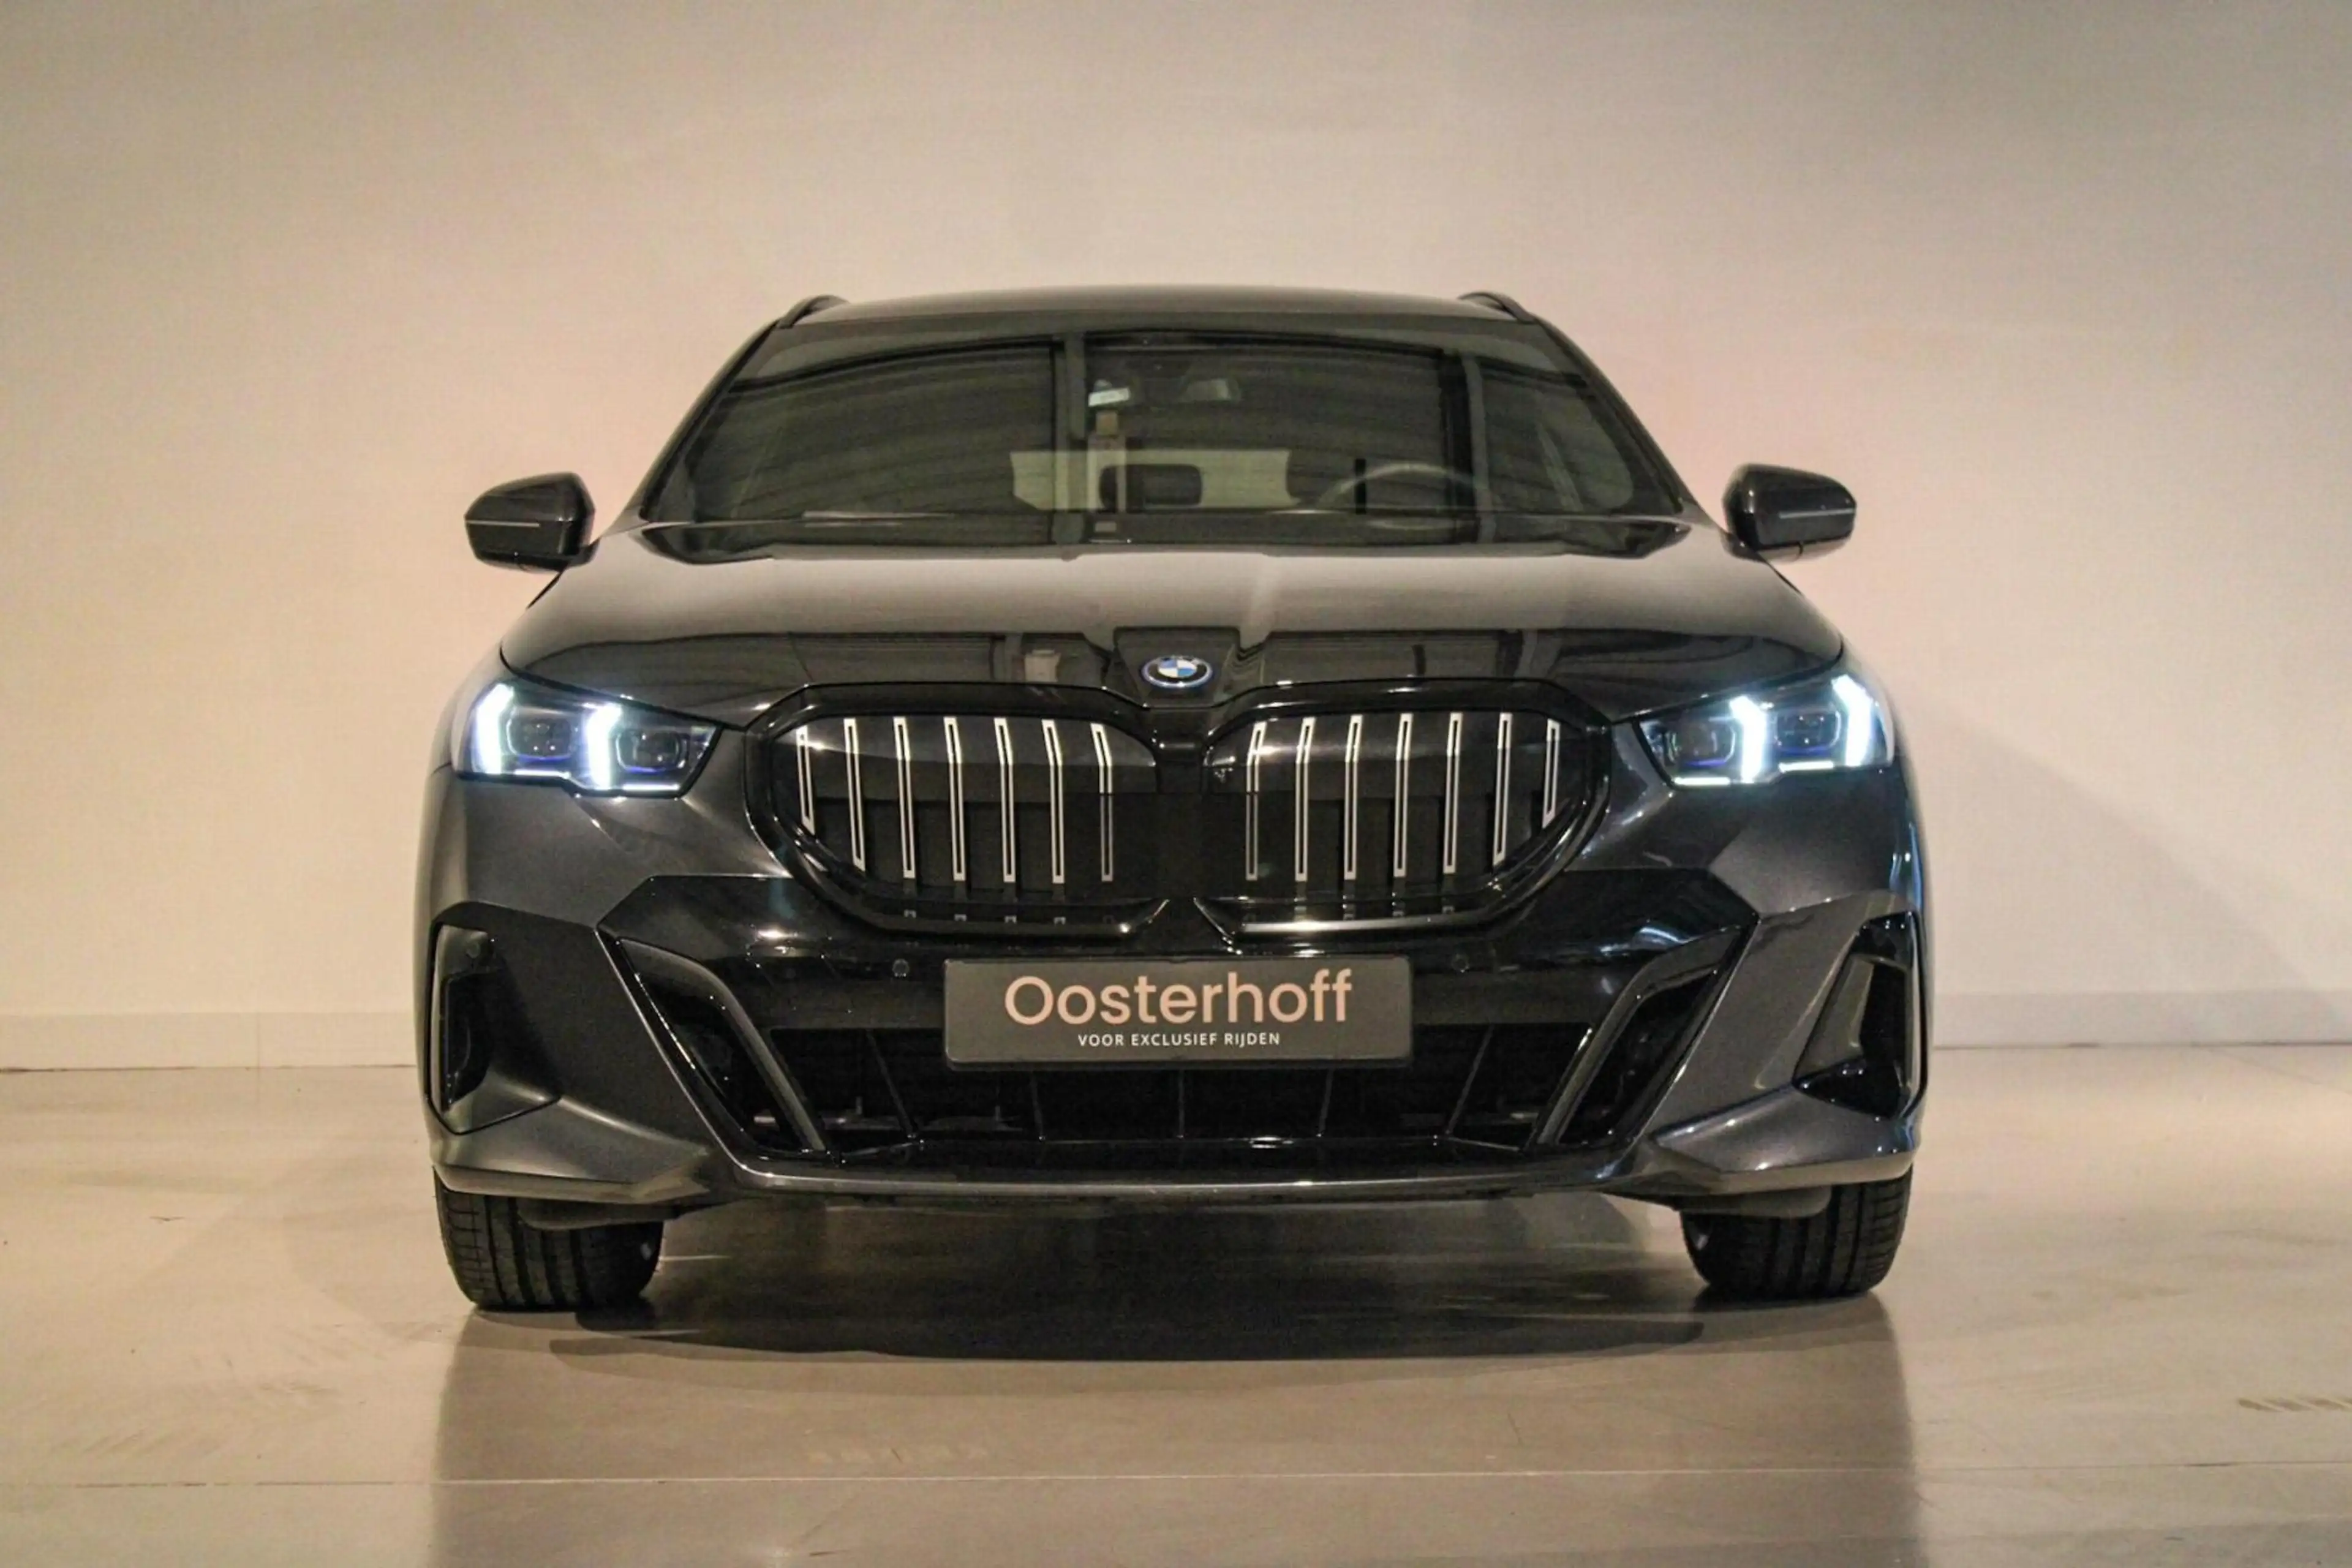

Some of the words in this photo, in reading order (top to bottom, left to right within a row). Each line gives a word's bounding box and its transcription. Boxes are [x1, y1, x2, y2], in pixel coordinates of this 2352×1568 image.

[1005, 968, 1352, 1025] Oosterhoff
[1077, 1033, 1125, 1047] VOOR
[1131, 1033, 1218, 1047] EXCLUSIEF
[1224, 1032, 1280, 1048] RIJDEN
